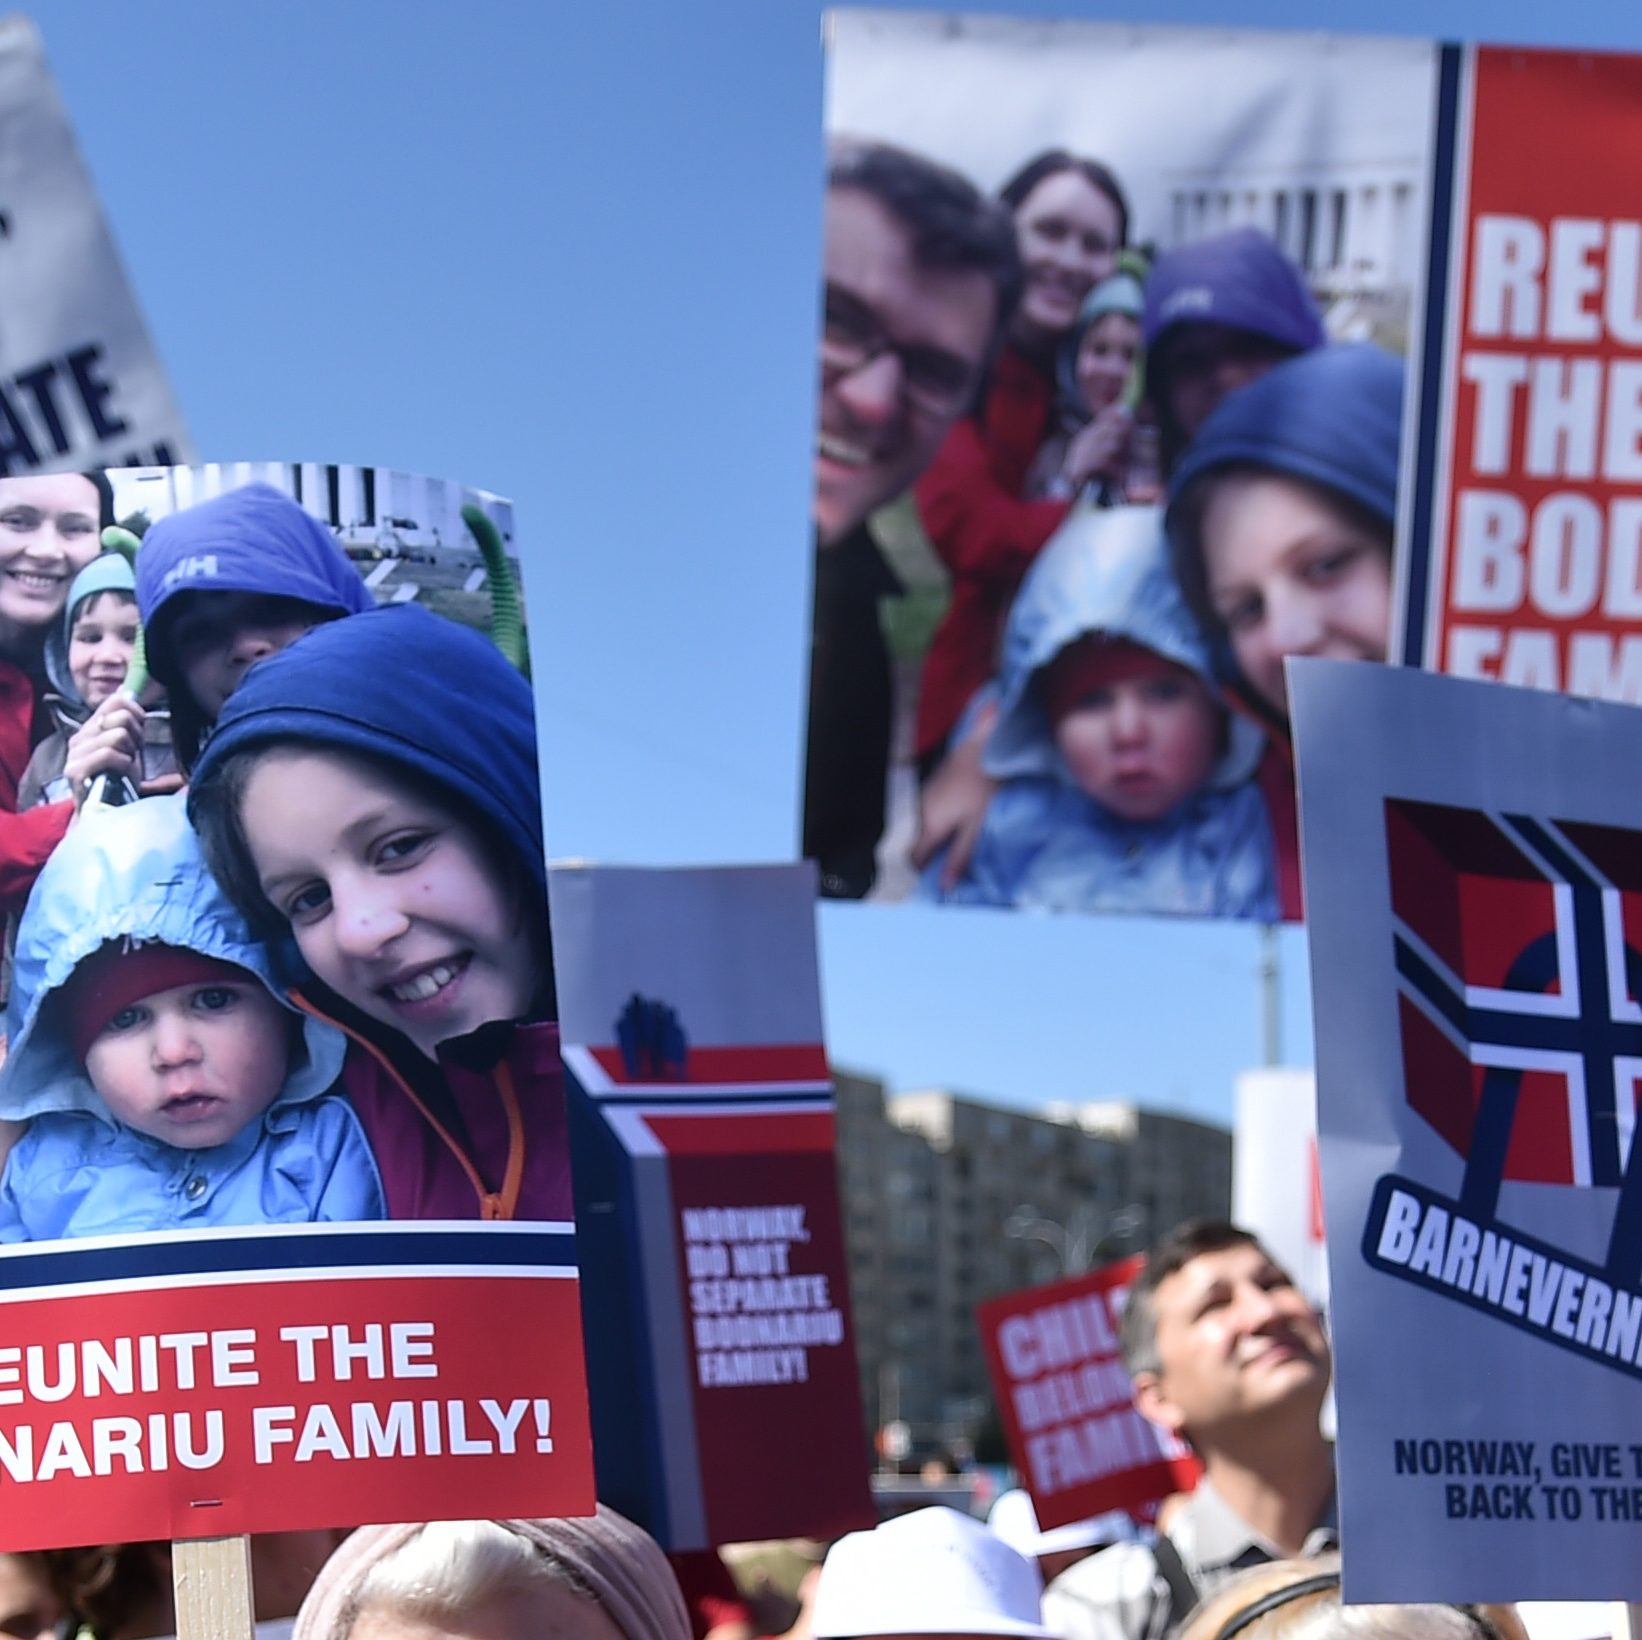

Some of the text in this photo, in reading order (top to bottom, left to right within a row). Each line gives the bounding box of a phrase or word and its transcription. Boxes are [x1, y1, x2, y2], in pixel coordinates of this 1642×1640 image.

[279, 1321, 439, 1382] THE
[252, 1398, 554, 1465] FAMILY!
[1394, 1439, 1543, 1485] NORWAY,
[1550, 1443, 1621, 1481] GIVE
[1445, 1483, 1536, 1521] BACK
[1541, 1485, 1582, 1521] TO
